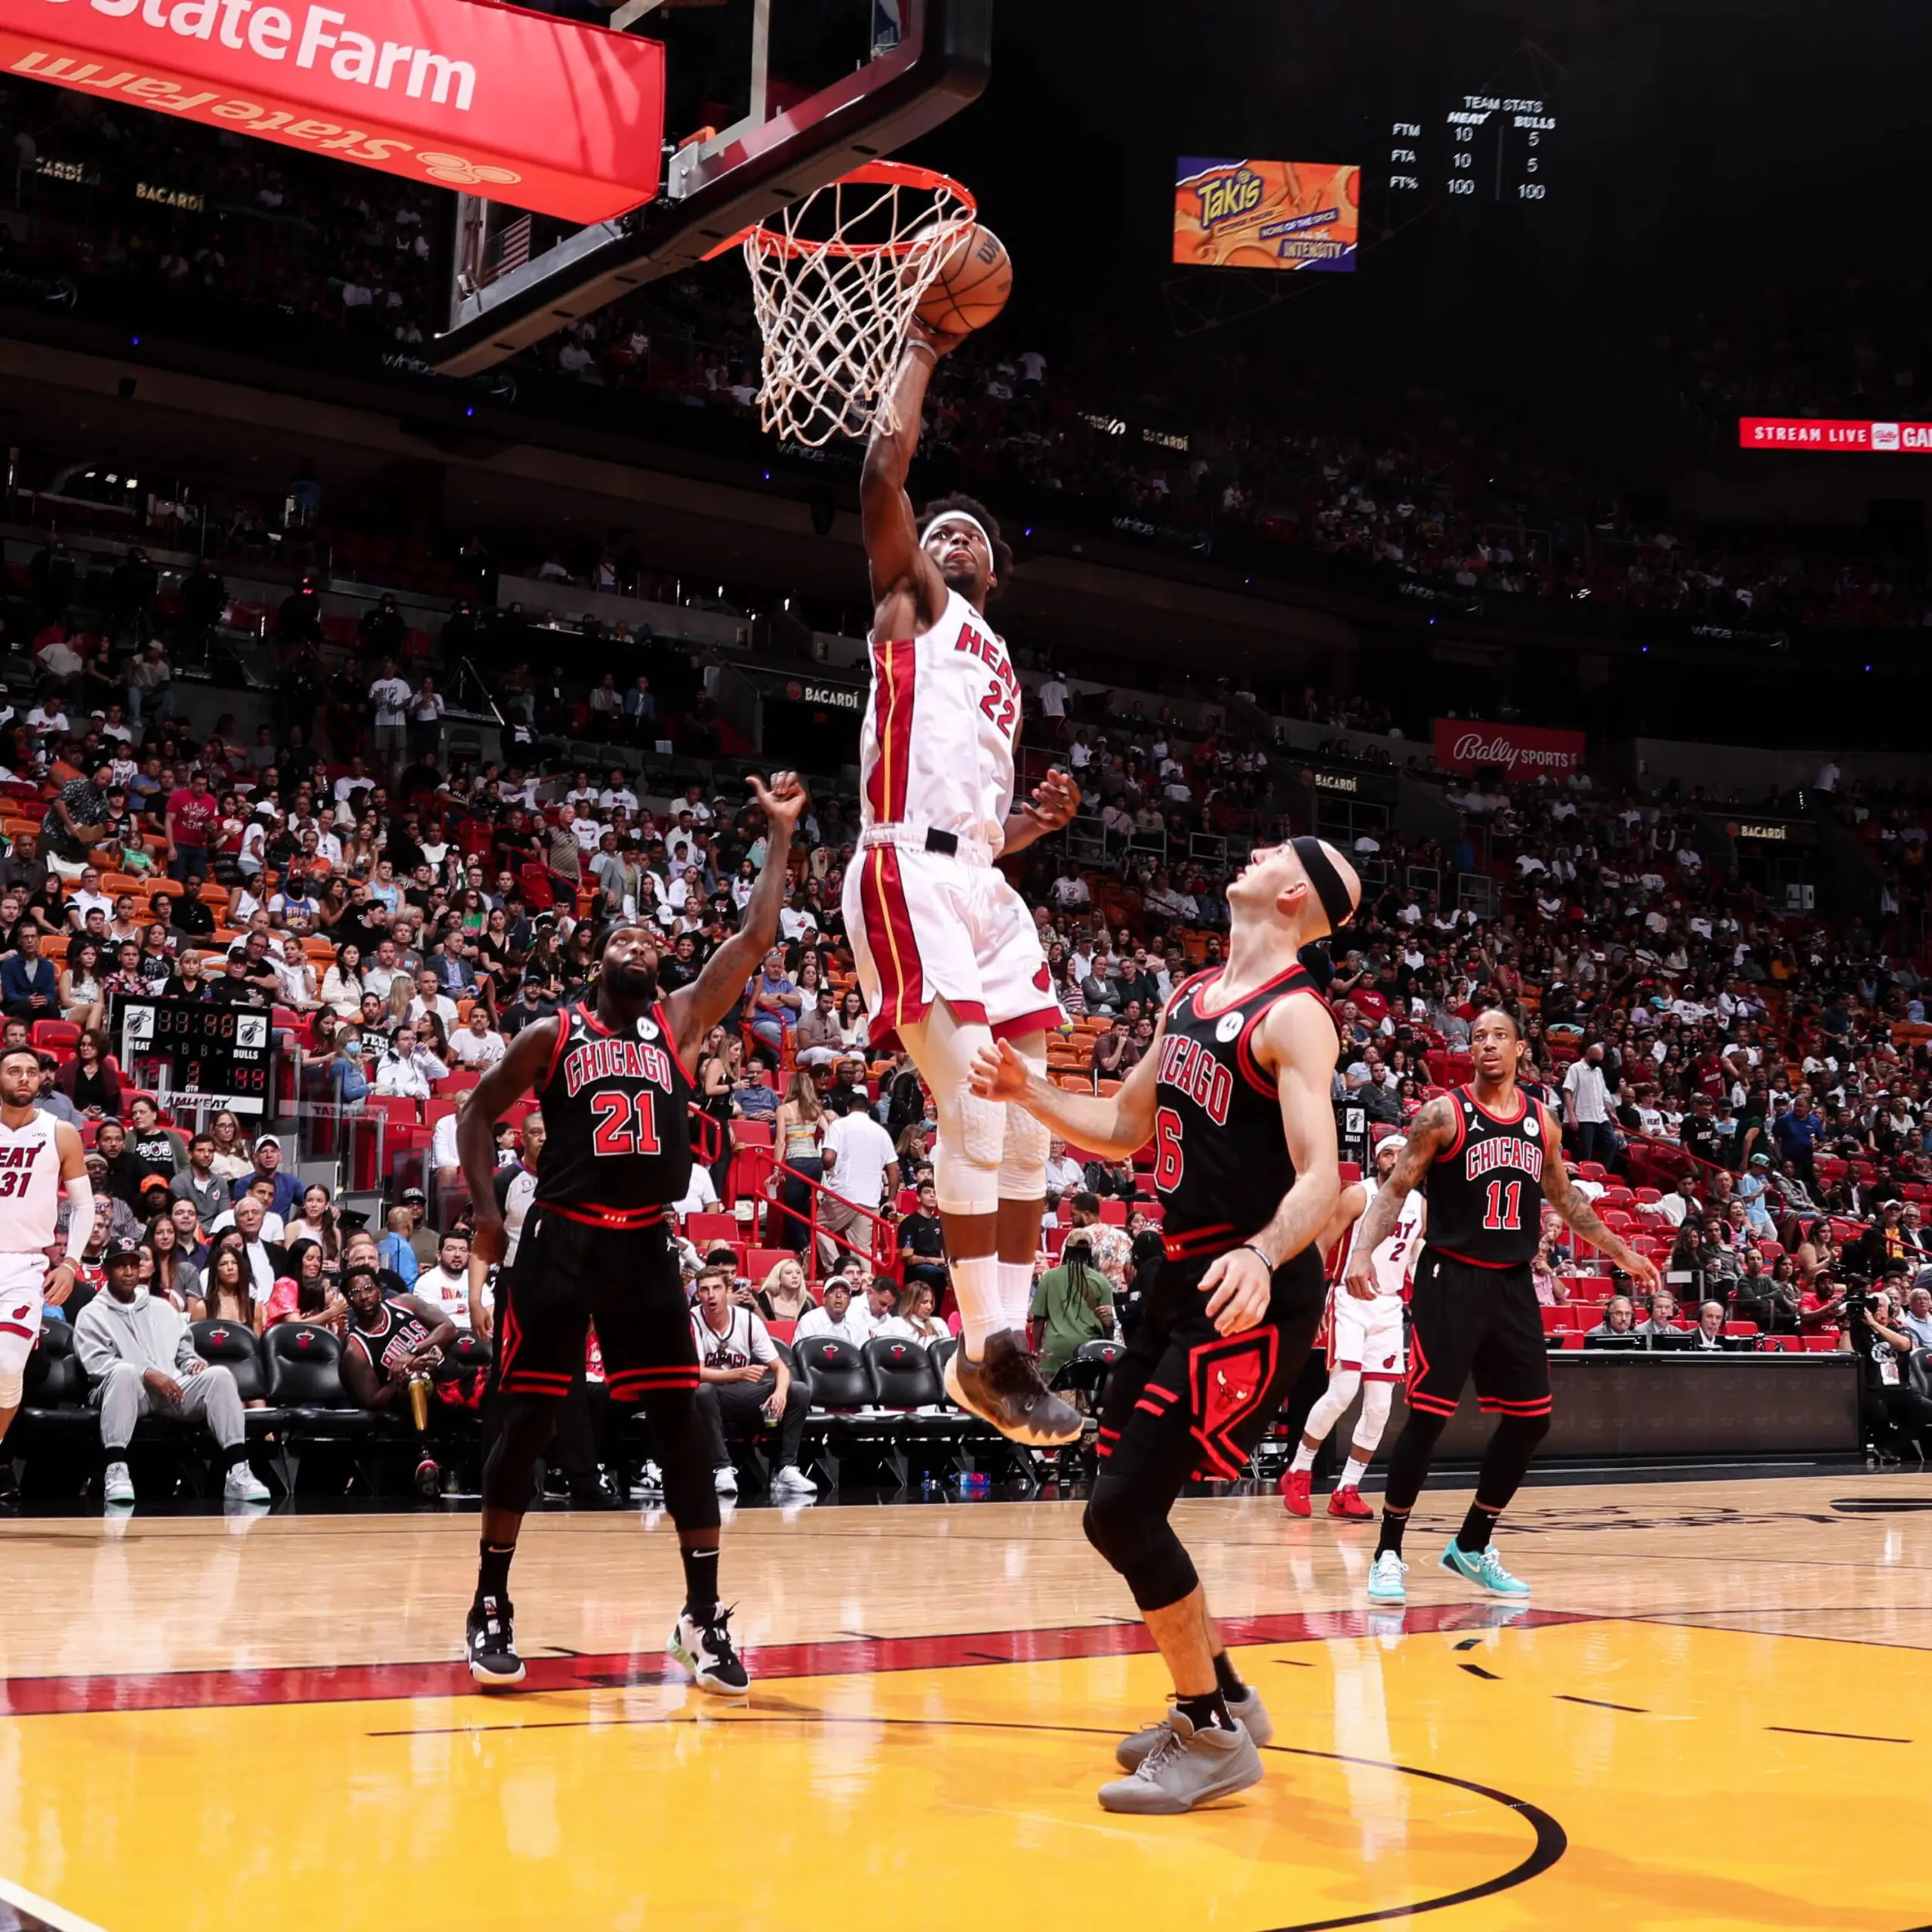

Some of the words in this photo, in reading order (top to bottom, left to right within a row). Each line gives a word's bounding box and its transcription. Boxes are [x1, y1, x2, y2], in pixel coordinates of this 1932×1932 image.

[89, 0, 293, 60] tate
[1463, 95, 1500, 110] TEAM
[1502, 98, 1544, 113] STATS
[1446, 111, 1492, 125] HEAT
[1513, 115, 1557, 129] BULLS
[1392, 122, 1421, 137] FTM
[1454, 126, 1474, 142] 10
[1527, 131, 1540, 146] 5
[1390, 149, 1417, 163] FTA
[1452, 152, 1472, 168] 10
[1526, 157, 1539, 173] 5
[1389, 175, 1419, 189] FT%
[1446, 179, 1475, 195] 100
[1197, 169, 1263, 227] Takis
[1517, 184, 1546, 200] 100
[1754, 426, 1822, 441] STREAM
[1829, 429, 1867, 443] LIVE
[804, 688, 859, 709] BACARDÍ
[979, 680, 1016, 739] 22
[1453, 733, 1521, 771] Bally
[1521, 751, 1569, 768] SPORTS
[1315, 774, 1358, 793] BACARDÍ
[1740, 825, 1787, 840] BACARDÍ
[128, 1040, 151, 1051] HEAT
[232, 1049, 259, 1060] BULLS
[565, 1038, 673, 1098] CHICAGO
[591, 1090, 661, 1156] 21
[1345, 1134, 1361, 1143] BULLS
[1697, 1129, 1713, 1140] HEAT
[0, 1140, 45, 1168] EAT
[136, 1140, 172, 1157] 305
[1154, 1106, 1183, 1193] 6
[1466, 1137, 1543, 1183] CHICAGO
[0, 1171, 32, 1198] 31
[1482, 1180, 1521, 1230] 11
[1391, 1219, 1417, 1240] AT
[1389, 1242, 1406, 1262] 2
[380, 1318, 431, 1370] BULLS
